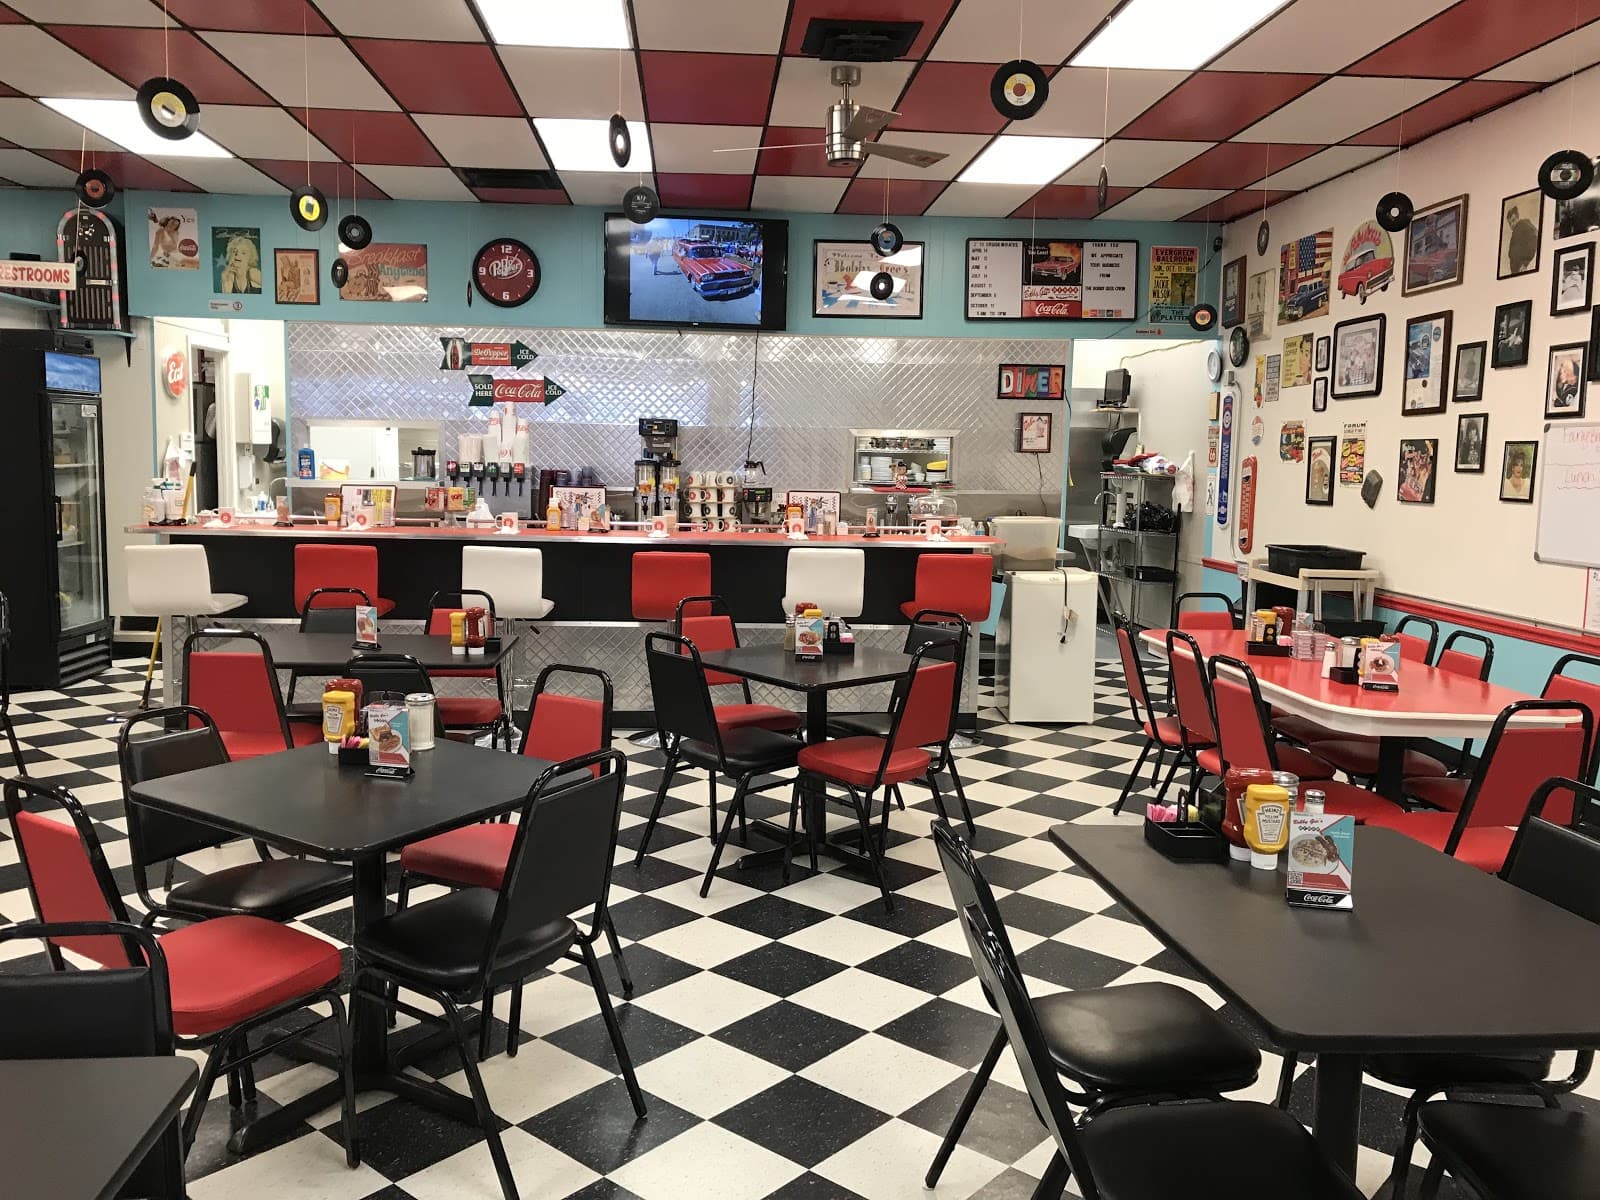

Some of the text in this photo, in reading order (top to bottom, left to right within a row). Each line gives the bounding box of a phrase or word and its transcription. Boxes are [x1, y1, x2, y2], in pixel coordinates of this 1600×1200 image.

[501, 245, 512, 253] 12
[1155, 248, 1195, 256] EVERGREEN
[1156, 255, 1193, 263] BALLROOM
[479, 267, 486, 275] 9
[527, 269, 534, 277] 3
[502, 292, 510, 300] 6
[1000, 367, 1064, 394] DINER
[494, 383, 541, 398] Coca-Cola
